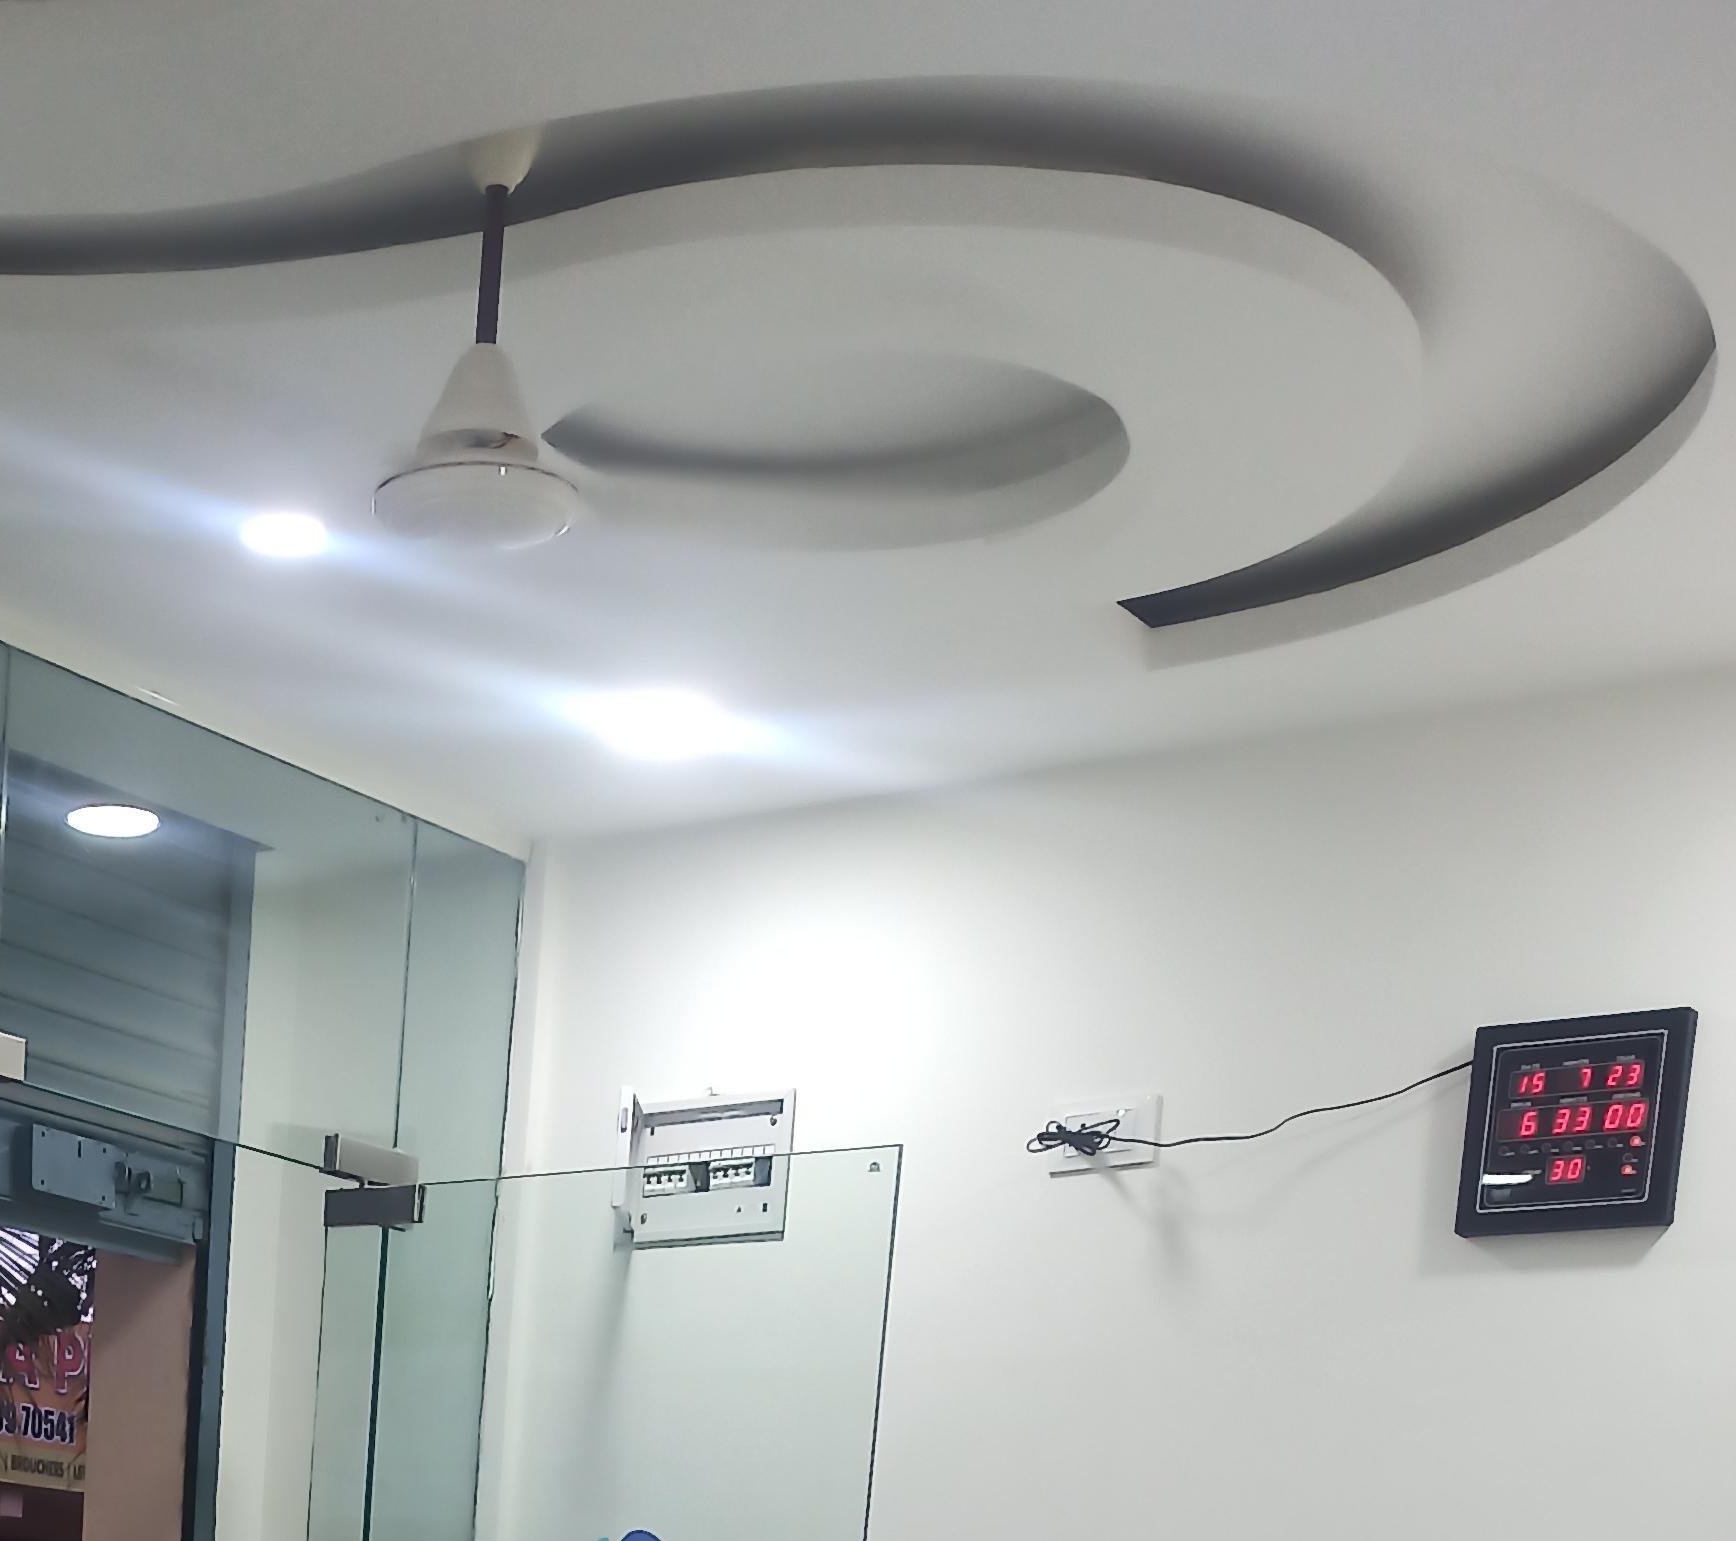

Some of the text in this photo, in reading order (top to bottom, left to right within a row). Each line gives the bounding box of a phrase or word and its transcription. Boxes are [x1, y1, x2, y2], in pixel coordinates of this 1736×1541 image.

[1518, 1064, 1641, 1093] 15 7 23
[1519, 1102, 1645, 1136] 6 33 00
[1549, 1157, 1582, 1182] 30
